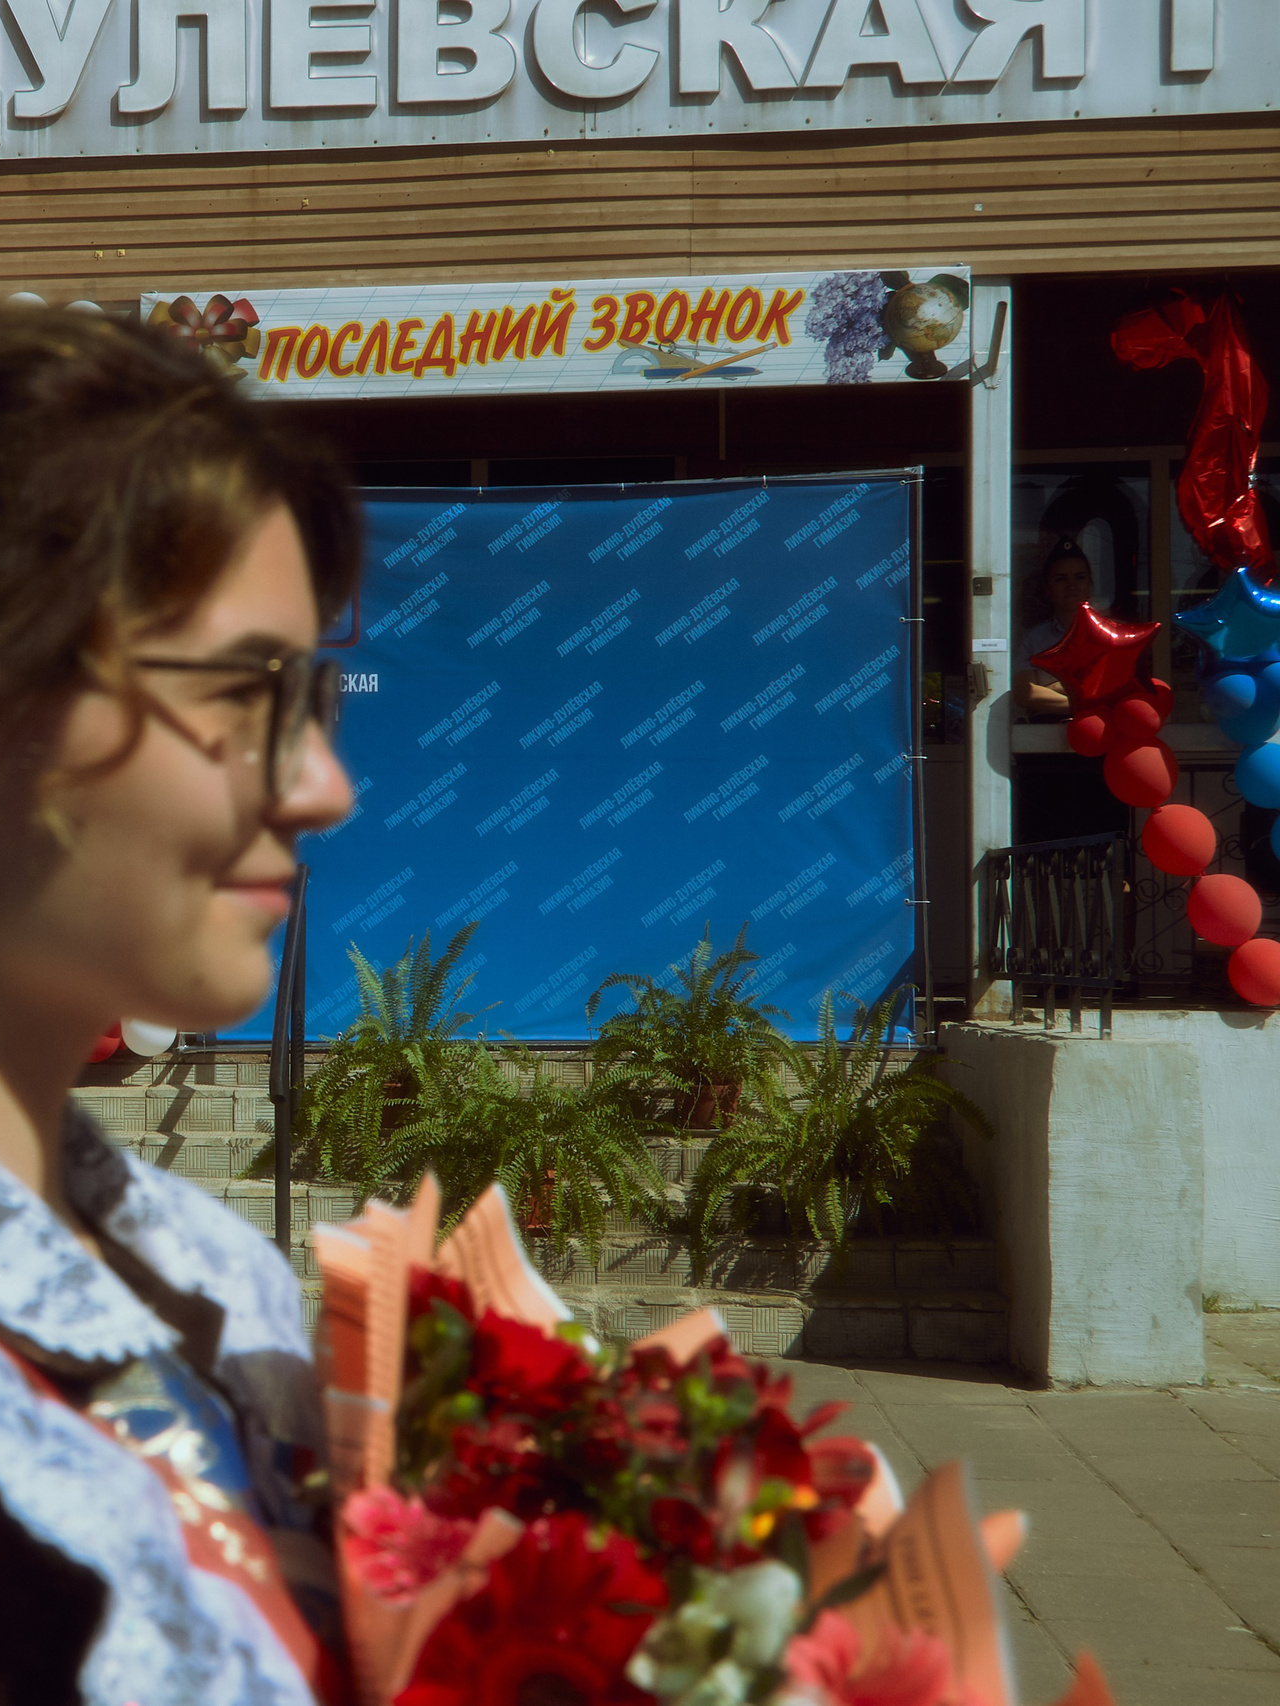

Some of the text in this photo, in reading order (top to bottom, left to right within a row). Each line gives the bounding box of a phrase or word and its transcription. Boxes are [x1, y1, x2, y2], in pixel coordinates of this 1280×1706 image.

[257, 286, 806, 383] ПОСЛЕДНИЙ ЗВОНОК
[410, 527, 458, 567] ГИМНАЗИЯ
[515, 513, 563, 553] ГИМНАЗИЯ
[616, 521, 664, 561] ГИМНАЗИЯ
[712, 518, 761, 558] ГИМНАЗИЯ
[813, 509, 860, 549] ГИМНАЗИЯ
[394, 598, 440, 638] ГИМНАЗИЯ
[494, 606, 541, 646] ГИМНАЗИЯ
[584, 615, 632, 655] ГИМНАЗИЯ
[683, 604, 731, 644] ГИМНАЗИЯ
[781, 603, 829, 643] ГИМНАЗИЯ
[748, 690, 796, 730] ГИМНАЗИЯ
[843, 672, 891, 712] ГИМНАЗИЯ
[445, 707, 492, 747] ГИМНАЗИЯ
[547, 707, 594, 747] ГИМНАЗИЯ
[648, 706, 696, 747] ГИМНАЗИЯ
[411, 789, 458, 829] ГИМНАЗИЯ
[503, 795, 550, 835] ГИМНАЗИЯ
[607, 788, 655, 828] ГИМНАЗИЯ
[712, 781, 760, 822] ГИМНАЗИЯ
[806, 780, 855, 820] ГИМНАЗИЯ
[359, 893, 406, 932] ГИМНАЗИЯ
[566, 874, 614, 914] ГИМНАЗИЯ
[669, 886, 717, 926] ГИМНАЗИЯ
[779, 879, 828, 920] ГИМНАЗИЯ
[542, 972, 590, 1012] ГИМНАЗИЯ
